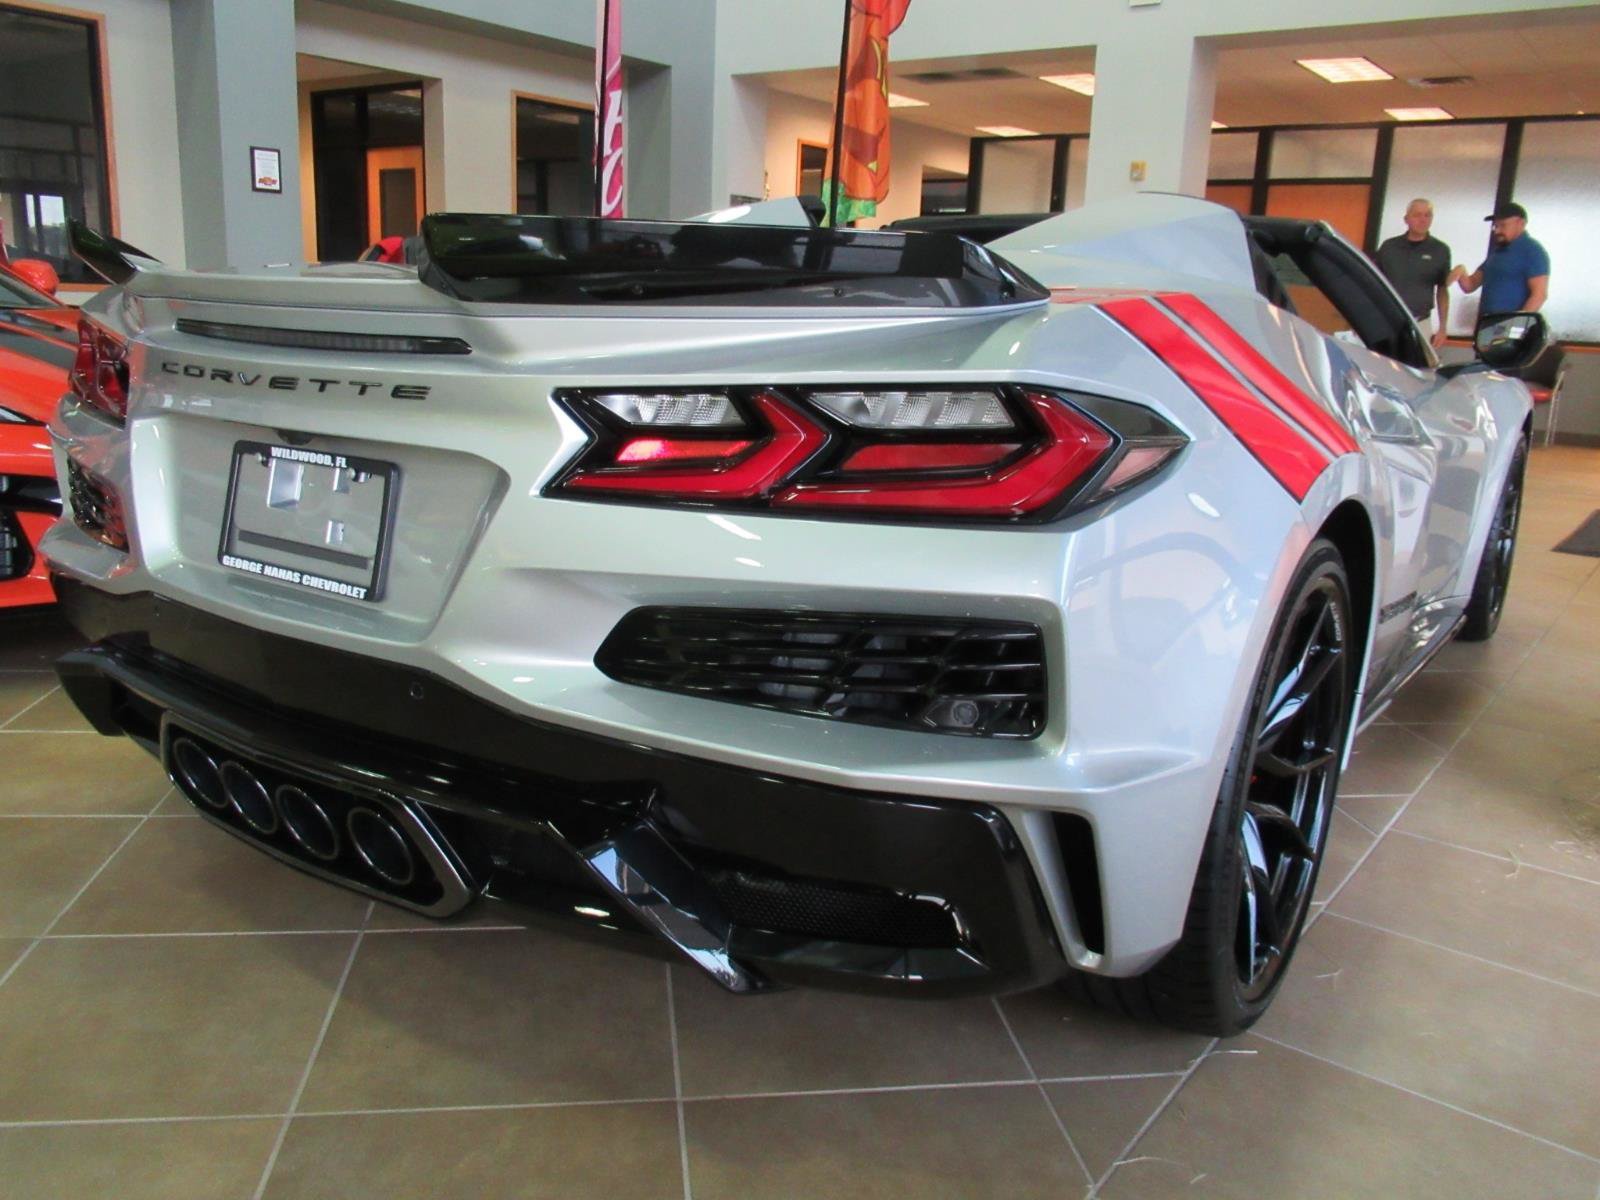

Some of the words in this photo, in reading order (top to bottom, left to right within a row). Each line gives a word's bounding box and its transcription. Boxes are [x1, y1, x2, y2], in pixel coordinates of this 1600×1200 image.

[161, 362, 431, 400] CORVETTE
[271, 446, 334, 467] WILDWOOD,
[335, 456, 347, 468] FL
[222, 555, 263, 574] GEORGE
[302, 575, 367, 600] CHEVROLET
